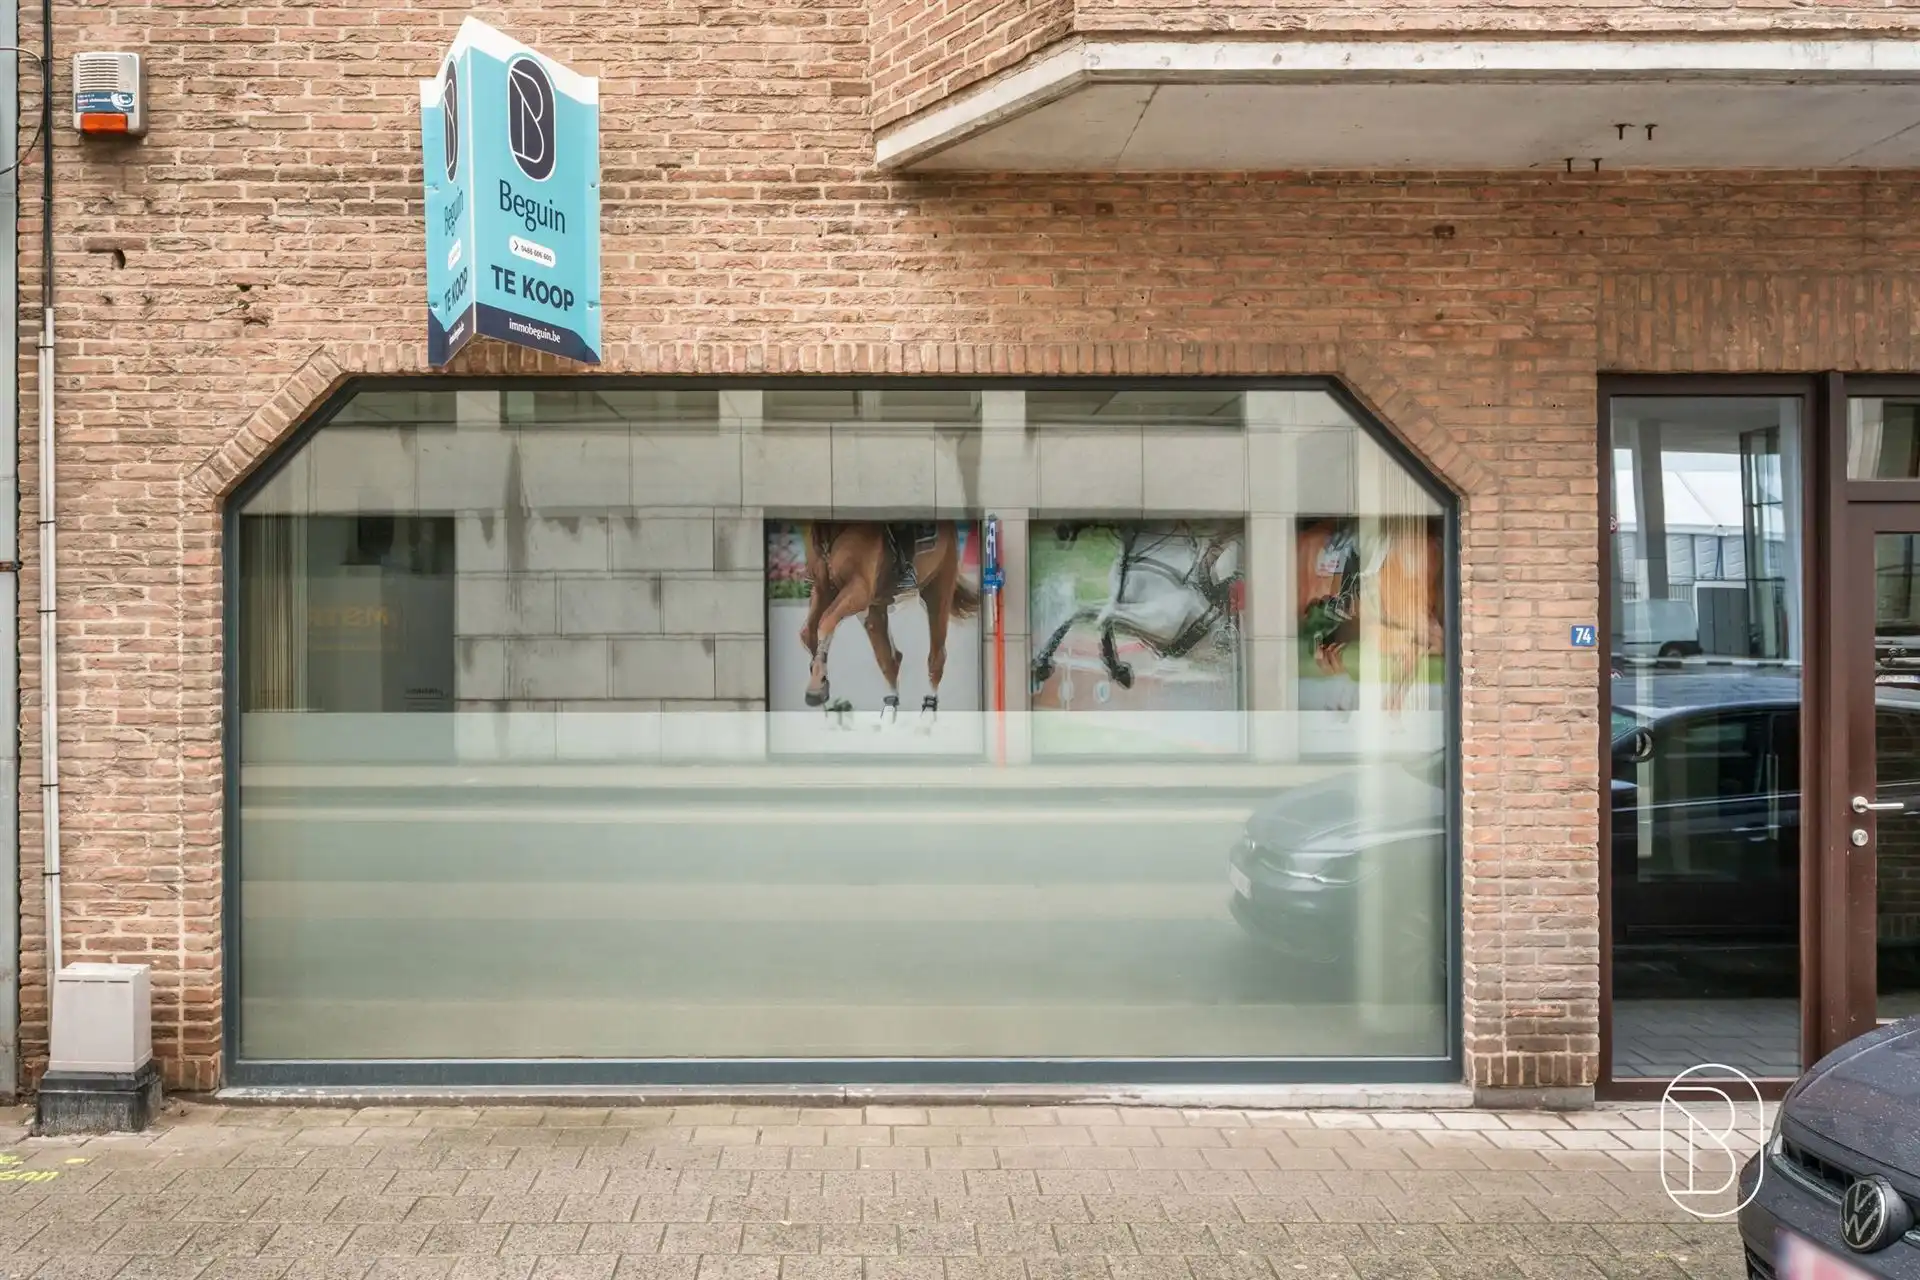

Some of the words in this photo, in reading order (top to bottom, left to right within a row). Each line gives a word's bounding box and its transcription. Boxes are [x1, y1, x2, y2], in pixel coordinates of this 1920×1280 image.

[444, 186, 464, 237] Beguin
[499, 179, 566, 234] Beguin
[444, 288, 452, 317] TE
[451, 266, 468, 306] KOOP
[490, 264, 517, 295] TE
[522, 275, 575, 311] KOOP
[508, 318, 561, 344] immobeguin.be
[1575, 627, 1592, 644] 74
